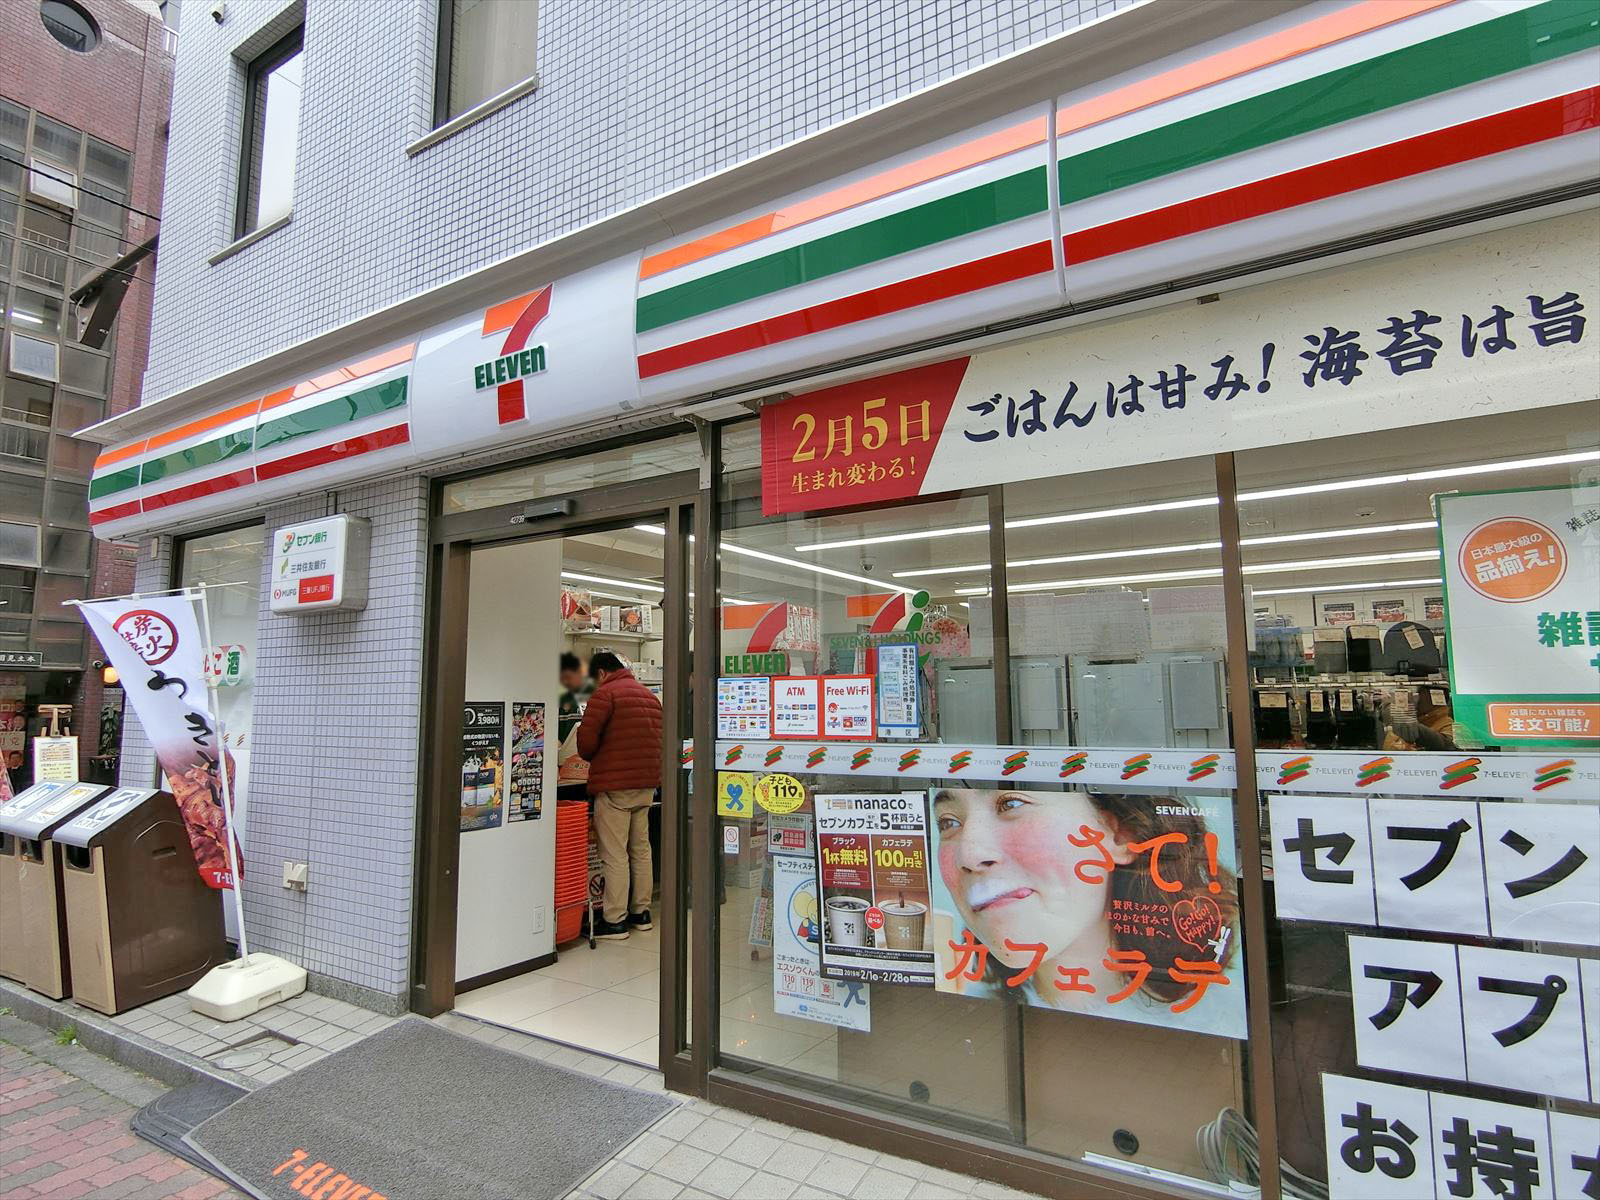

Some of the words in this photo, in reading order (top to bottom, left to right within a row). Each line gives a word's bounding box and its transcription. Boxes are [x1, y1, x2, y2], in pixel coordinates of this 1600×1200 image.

[791, 398, 931, 463] 2月5日
[791, 456, 916, 494] 生まれ変わる!
[297, 531, 327, 546] セブン銀行
[1471, 533, 1543, 560] 日本最大級の
[290, 559, 327, 574] 三井住友銀行
[1475, 545, 1556, 584] 品揃え!
[227, 651, 240, 675] 酒
[786, 687, 806, 696] ATM
[826, 686, 844, 696] Free
[846, 686, 869, 696] Wi-Fi
[1508, 718, 1590, 732] 注文可能!
[769, 776, 792, 785] 子ども
[1155, 805, 1189, 816] SEVEN
[832, 837, 856, 845] ブラック
[882, 839, 913, 847] カフェラテ
[822, 847, 868, 865] 1杯無料
[1067, 824, 1222, 894] さて!
[1282, 817, 1588, 899] セブン
[1113, 900, 1169, 913] 贅沢ミルクの
[1104, 912, 1169, 926] ほのかな甘みで
[945, 928, 1231, 1014] カフェラテ
